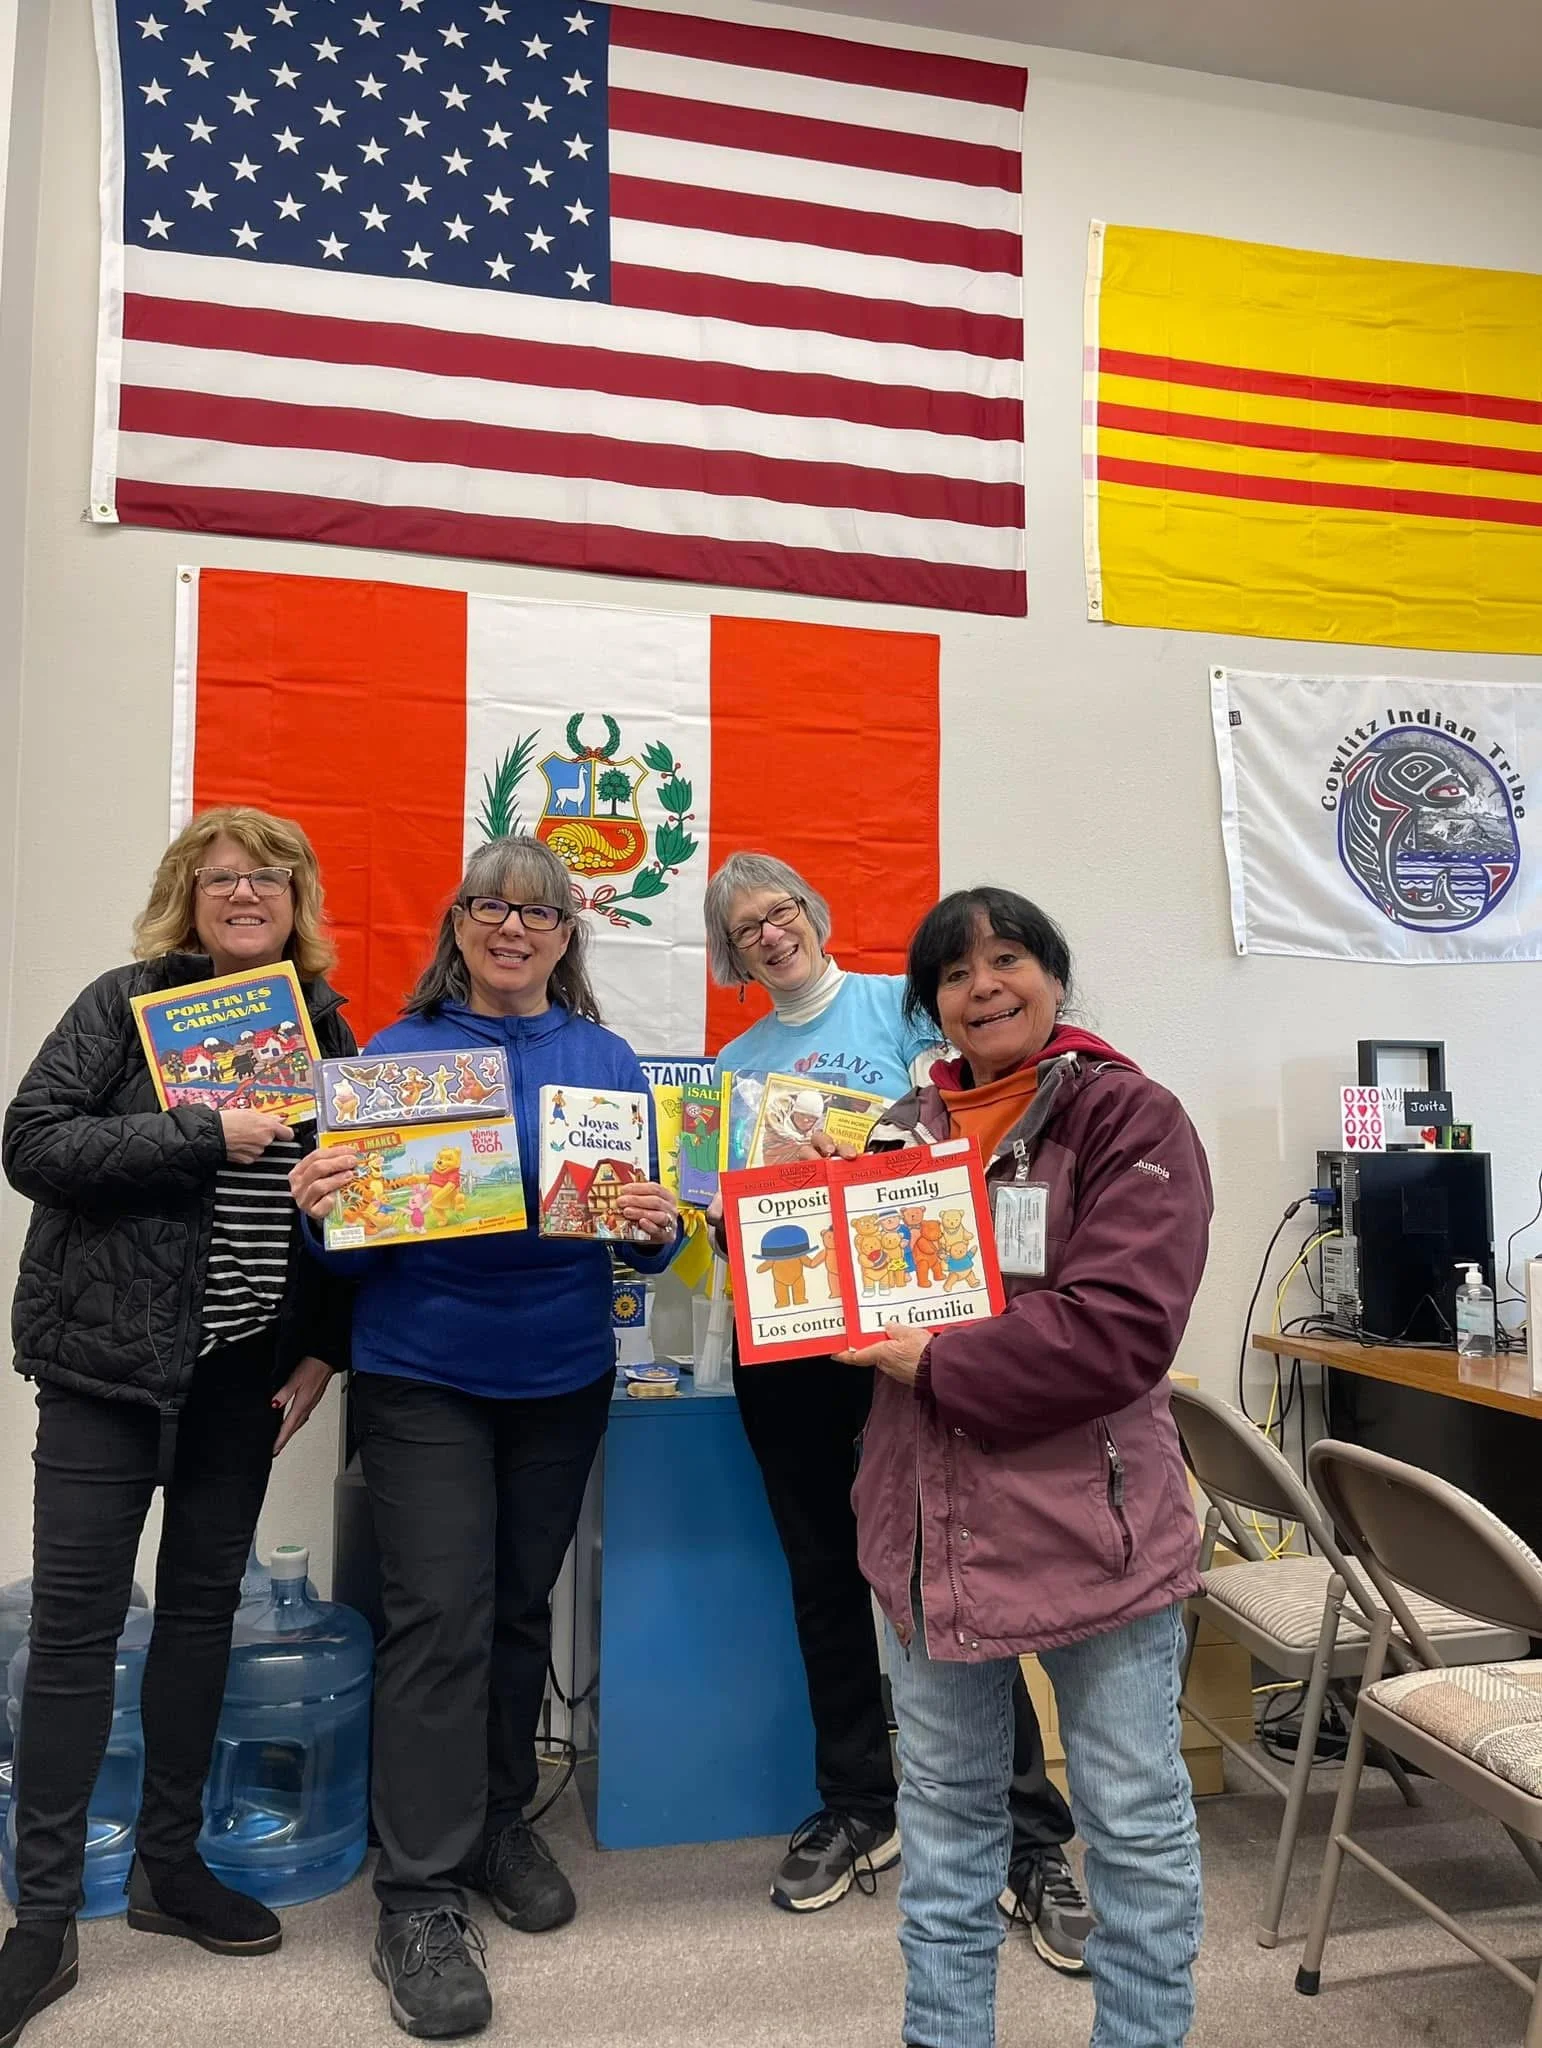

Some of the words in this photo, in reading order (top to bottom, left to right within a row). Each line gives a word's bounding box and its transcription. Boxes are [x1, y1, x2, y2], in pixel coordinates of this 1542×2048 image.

[1321, 719, 1380, 811] Cowlitz
[1387, 708, 1477, 743] Indian
[1489, 742, 1526, 820] Tribe
[165, 1002, 210, 1020] POR
[212, 993, 243, 1009] FIN
[246, 986, 272, 1001] ES
[172, 1001, 272, 1032] CARNAVAL
[687, 1086, 721, 1101] ¡SALT
[1343, 1088, 1380, 1103] OXO
[469, 1129, 500, 1140] Winnie
[578, 1114, 620, 1133] Joyas
[1344, 1119, 1382, 1134] OXO
[472, 1138, 503, 1154] Pooh
[568, 1130, 632, 1151] Clásicas
[876, 1178, 940, 1204] Family
[758, 1190, 829, 1215] Opposit
[908, 1300, 975, 1324] familia
[757, 1321, 787, 1338] Los
[792, 1314, 846, 1335] contra
